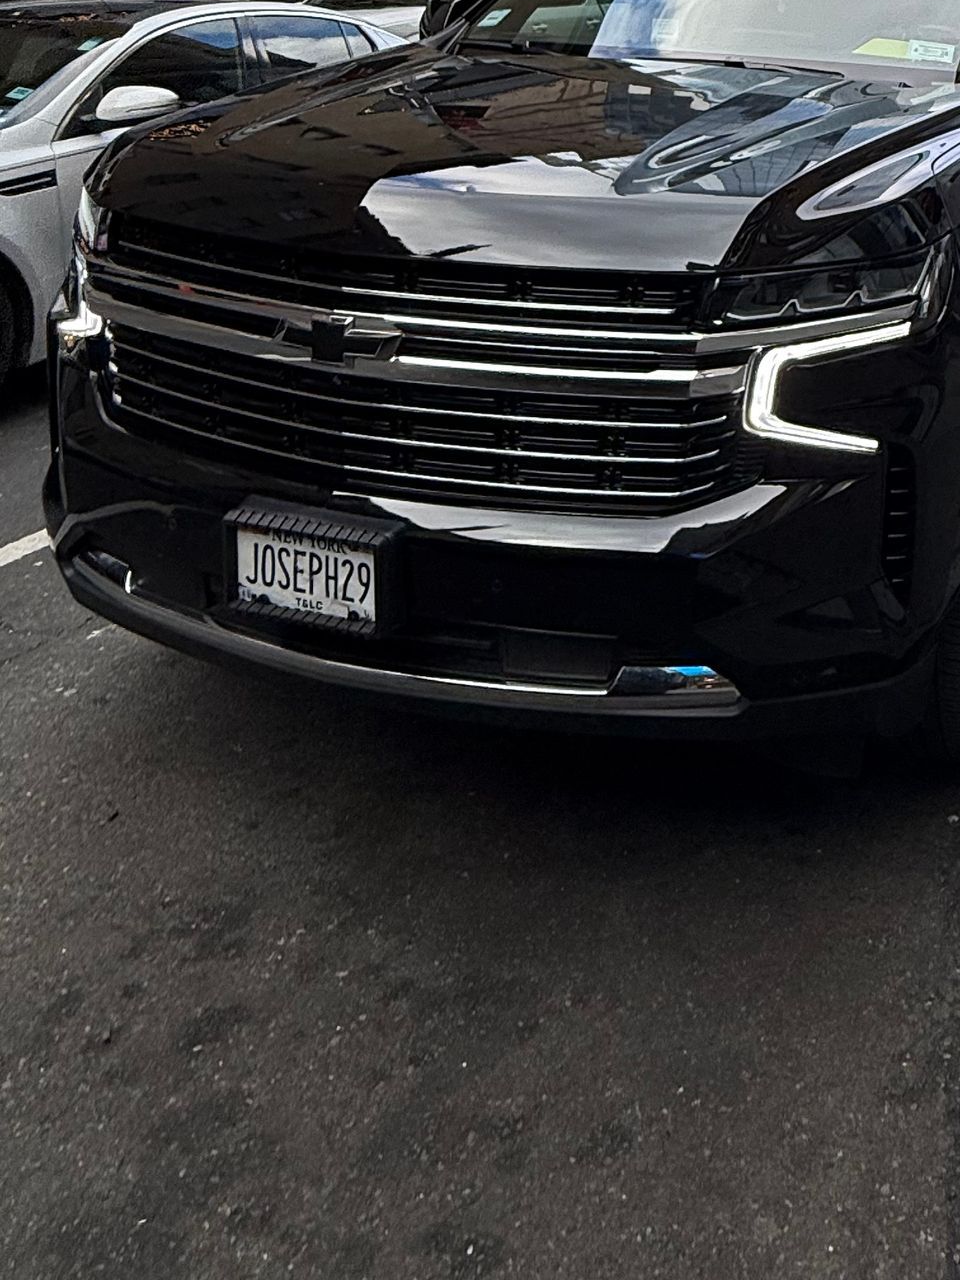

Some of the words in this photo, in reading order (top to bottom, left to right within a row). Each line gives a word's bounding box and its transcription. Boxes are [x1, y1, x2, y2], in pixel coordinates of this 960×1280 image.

[272, 528, 304, 544] NEW
[310, 535, 349, 554] YORK
[245, 542, 372, 605] JOSEPH29
[295, 597, 324, 611] T&LC
